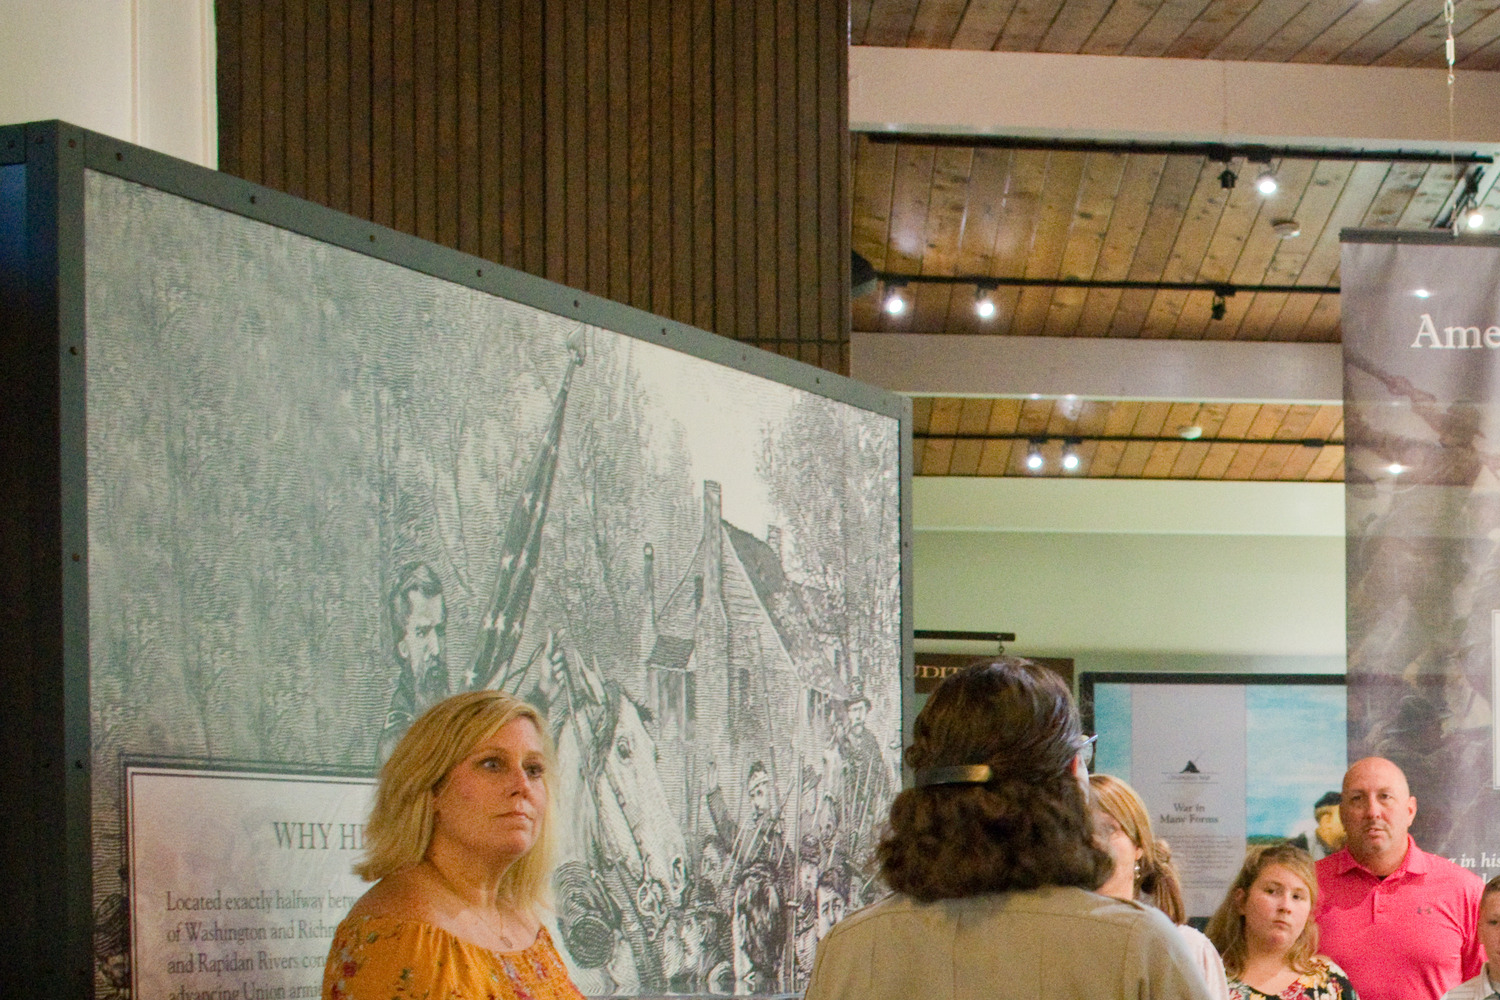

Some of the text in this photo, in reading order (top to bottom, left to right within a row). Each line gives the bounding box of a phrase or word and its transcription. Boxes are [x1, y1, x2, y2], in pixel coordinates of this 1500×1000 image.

[1160, 813, 1219, 825] Many Forms
[1173, 803, 1206, 813] War in
[272, 822, 333, 850] WHY
[1461, 853, 1477, 868] in
[166, 890, 222, 912] Located
[224, 889, 272, 914] exactly
[275, 889, 324, 914] halfway
[166, 921, 182, 943] of
[184, 920, 268, 946] Washington
[270, 919, 295, 941] and
[167, 951, 328, 977] and Rapidan Rivers con
